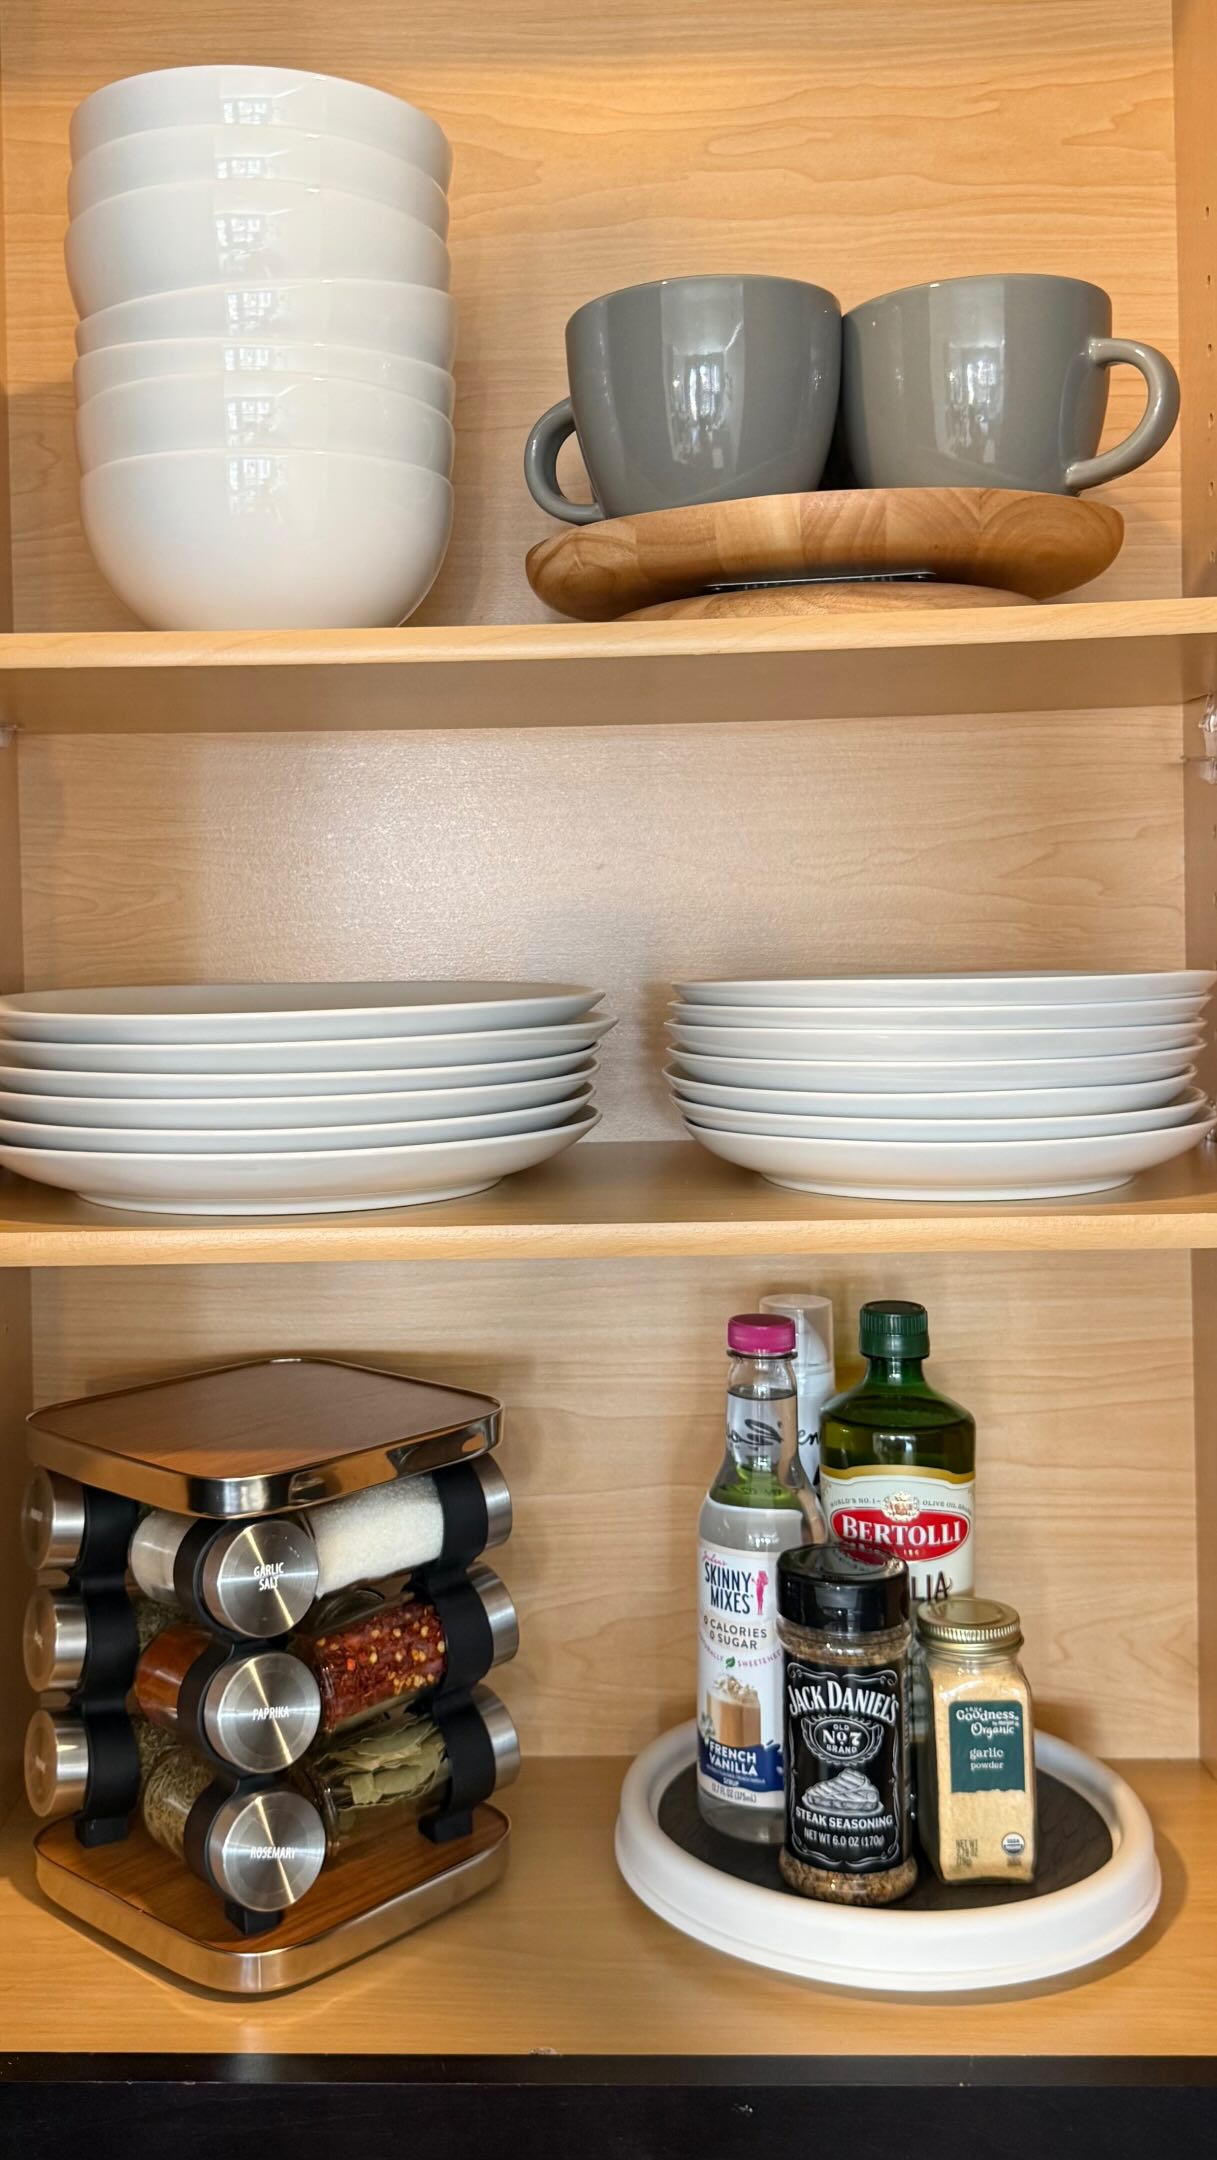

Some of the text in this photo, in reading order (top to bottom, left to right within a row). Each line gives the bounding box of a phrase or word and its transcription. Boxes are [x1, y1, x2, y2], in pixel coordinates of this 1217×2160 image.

[922, 1499, 945, 1507] OLIVE
[841, 1514, 961, 1547] BERTOLLI
[253, 1562, 285, 1578] GARLIC
[704, 1561, 751, 1593] SKINNY
[258, 1576, 279, 1592] SALT
[710, 1584, 750, 1614] MIXES
[710, 1618, 767, 1638] CALORIES
[717, 1633, 758, 1650] SUGAR
[787, 1680, 899, 1724] JACK DANIEL'S
[252, 1705, 290, 1721] PAPRIKA
[955, 1708, 1015, 1721] Goodness
[833, 1723, 850, 1731] OLD
[970, 1721, 1015, 1740] Organic
[709, 1740, 757, 1765] FRENCH
[826, 1744, 858, 1754] BRAND
[969, 1747, 1004, 1761] garlic
[708, 1751, 759, 1777] VANILLA
[970, 1761, 1003, 1772] powder
[795, 1805, 893, 1830] STEAK SEASONING
[803, 1827, 817, 1840] NET
[819, 1832, 831, 1843] WT
[832, 1834, 847, 1846] 6.0
[848, 1836, 860, 1847] OZ
[249, 1846, 296, 1860] ROSEMARY
